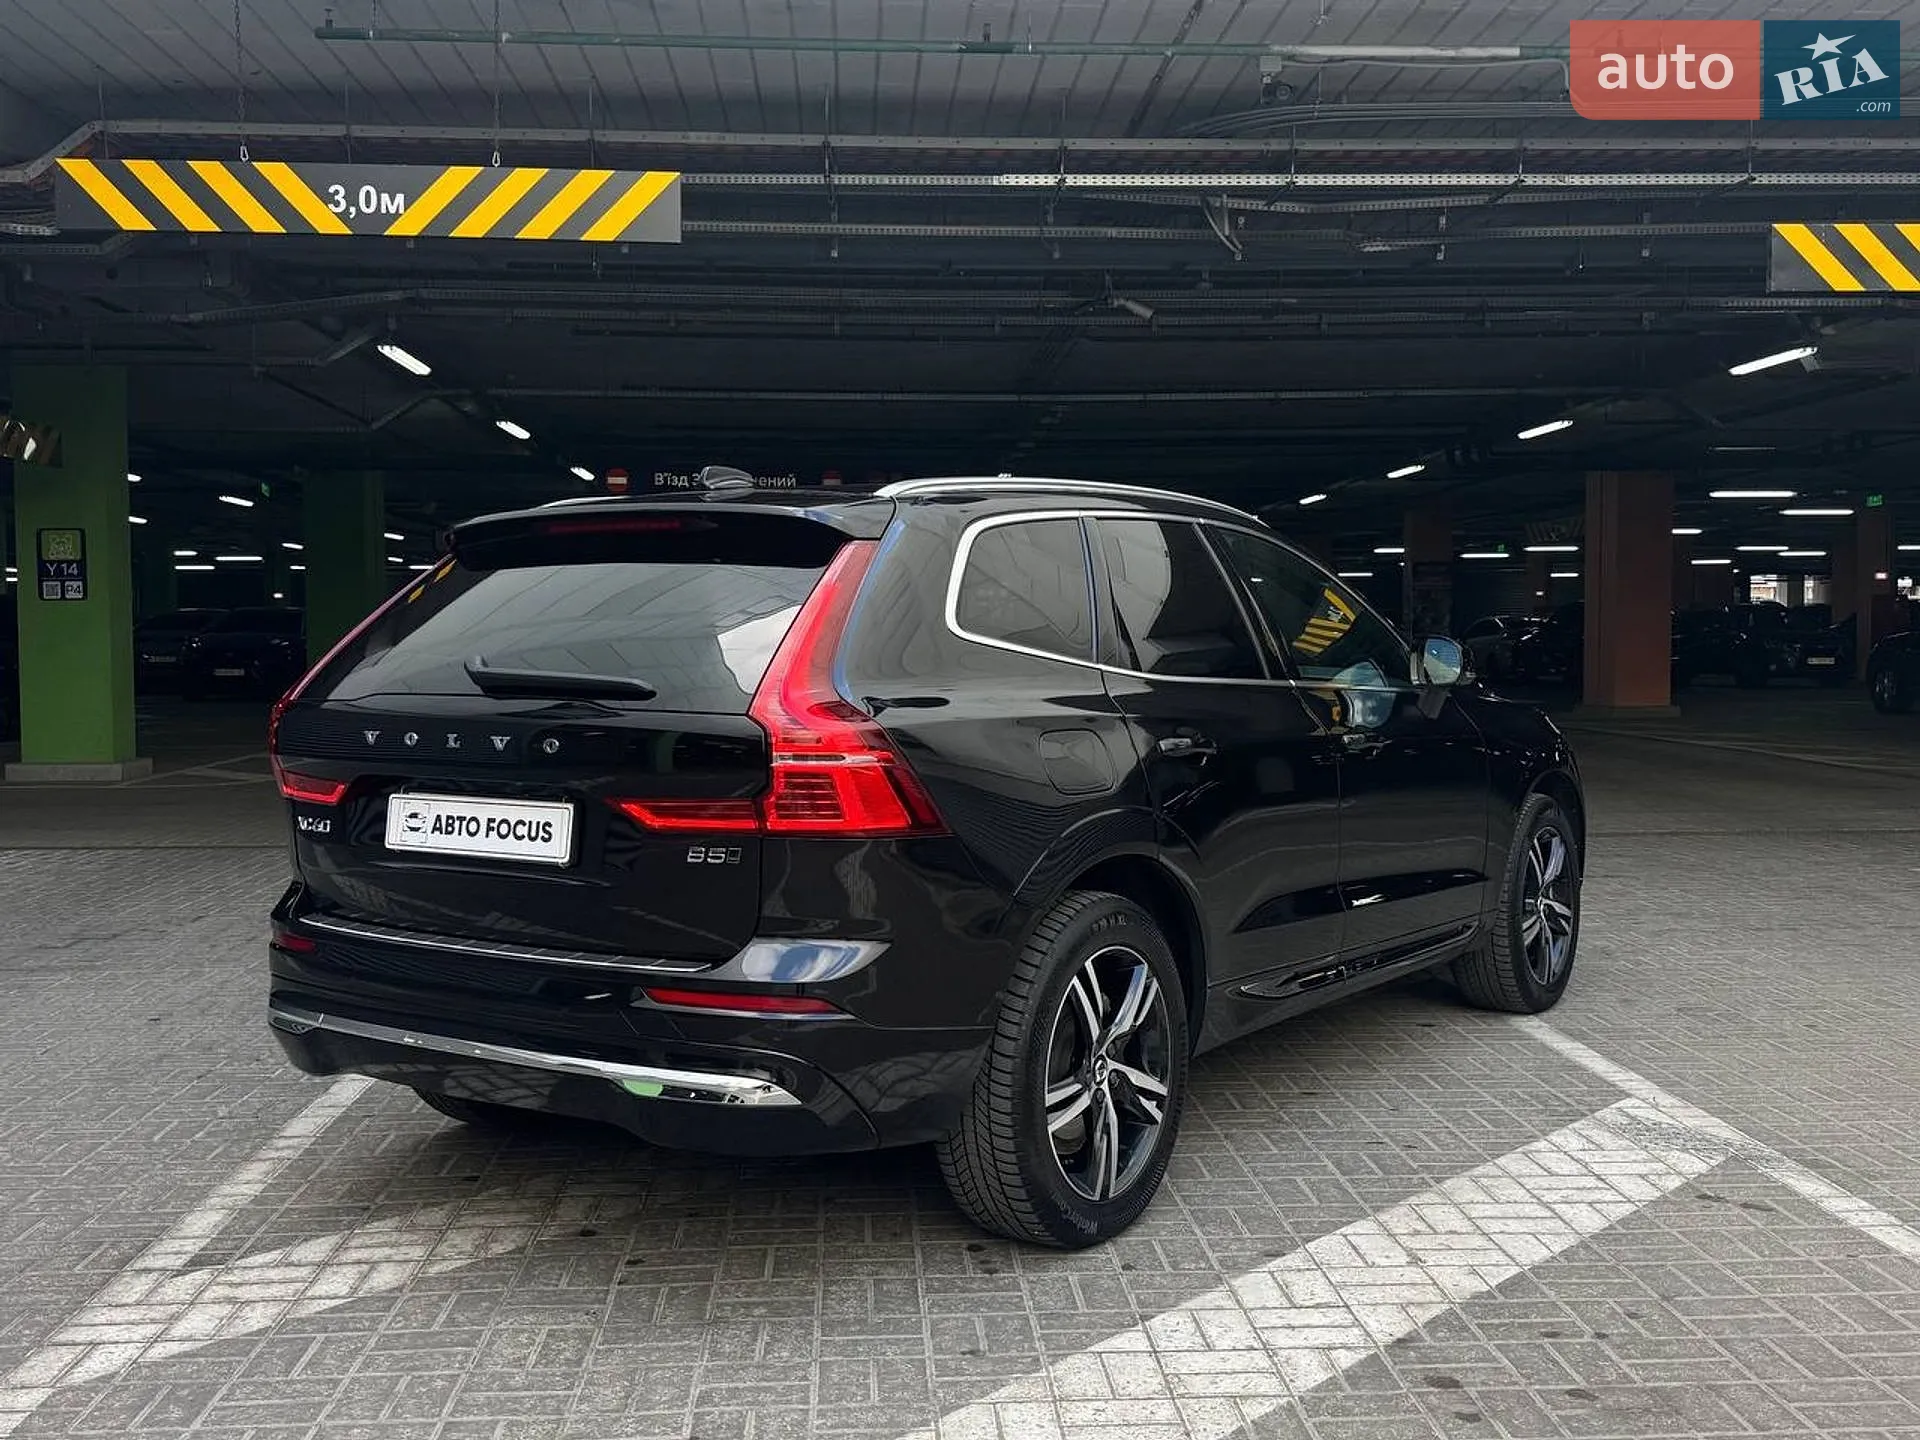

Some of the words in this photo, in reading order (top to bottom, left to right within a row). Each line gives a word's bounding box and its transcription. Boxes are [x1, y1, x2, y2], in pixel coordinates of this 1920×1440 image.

[327, 184, 406, 219] 3,0м
[60, 562, 78, 576] 14
[364, 730, 560, 754] VOLVO
[484, 817, 553, 843] FOCUS
